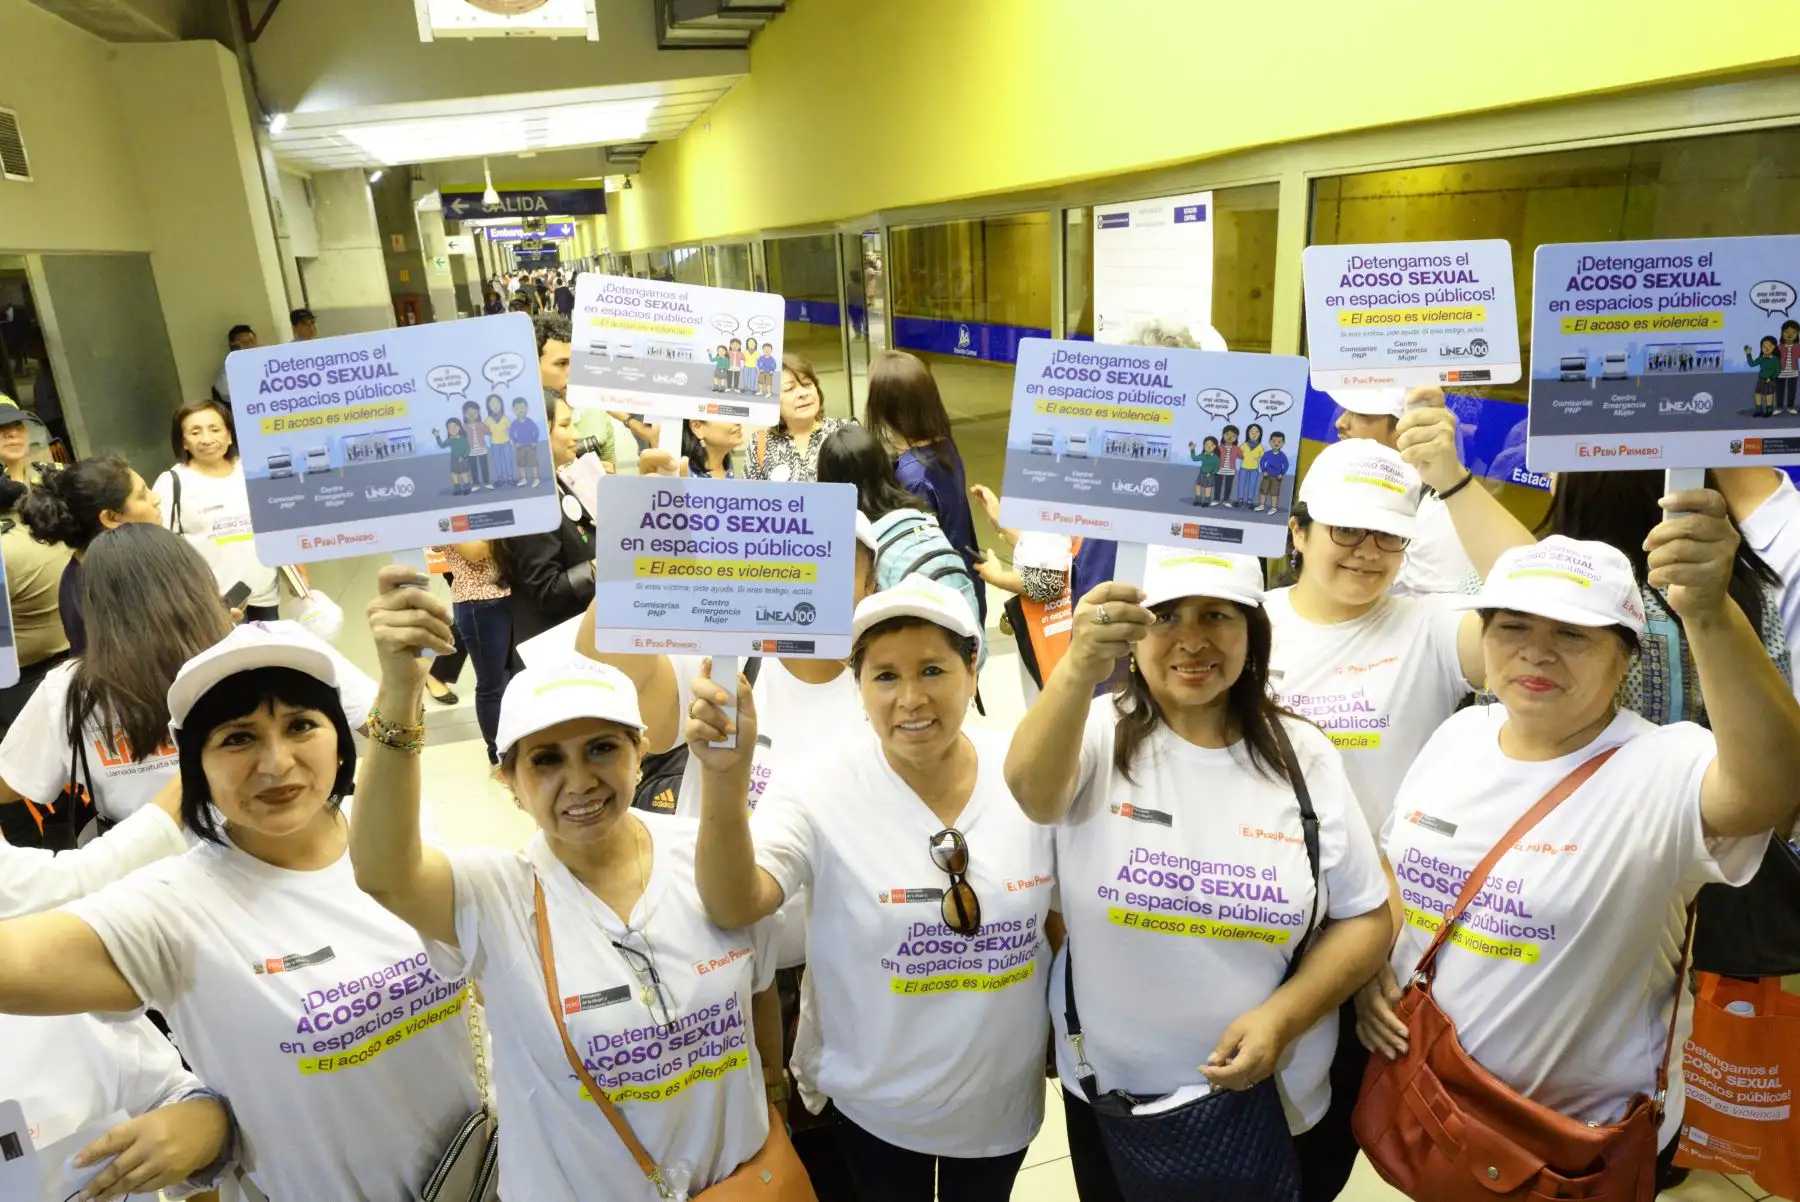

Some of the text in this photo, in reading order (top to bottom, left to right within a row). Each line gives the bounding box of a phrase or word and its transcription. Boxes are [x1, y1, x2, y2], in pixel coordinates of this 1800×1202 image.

[490, 227, 533, 239] Embarq
[1347, 252, 1469, 272] ¡Detengamos el
[1577, 252, 1712, 274] ¡Detengamos el
[1339, 270, 1479, 288] ACOSO SEXUAL
[1566, 272, 1721, 292] ACOSO SEXUAL
[603, 283, 688, 300] ¡Detengamos el
[1326, 287, 1495, 308] en espacios públicos!
[1549, 299, 1569, 312] en
[1575, 294, 1653, 314] espacios
[1658, 291, 1737, 312] públicos!
[584, 305, 598, 314] en
[601, 307, 651, 320] espacios
[654, 312, 703, 325] públicos!
[596, 294, 694, 313] ACOSO SEXUAL
[1352, 310, 1473, 324] El acoso es violencia
[1575, 315, 1709, 331] El acoso es violencia
[264, 345, 387, 375] ¡Detengamos el
[1051, 350, 1167, 371] ¡Detengamos el
[258, 362, 398, 395] ACOSO SEXUAL
[1042, 366, 1174, 389] ACOSO SEXUAL
[246, 401, 266, 415] en
[270, 389, 341, 413] espacios
[345, 378, 416, 405] públicos!
[1026, 383, 1044, 394] en
[1048, 385, 1114, 403] espacios
[1118, 390, 1186, 407] públicos!
[273, 405, 394, 431] El acoso es violencia
[1046, 402, 1160, 423] El acoso es violencia
[652, 491, 804, 513] ¡Detengamos el
[640, 512, 814, 535] ACOSO SEXUAL
[621, 538, 831, 559] en espacios públicos!
[651, 561, 800, 579] El acoso es violencia
[692, 607, 741, 616] Emergencia
[701, 599, 729, 607] Centro
[704, 615, 728, 624] Mujer
[1332, 736, 1368, 746] lencia
[1129, 847, 1276, 881] ¡Detengamos el
[1117, 866, 1289, 904] ACOSO SEXUAL
[1506, 879, 1523, 895] el
[1098, 885, 1304, 926] en espacios públicos!
[1471, 891, 1532, 919] EXUAL
[1026, 914, 1037, 929] el
[1124, 912, 1276, 943] El acoso es violencia
[1472, 912, 1556, 940] públicos!
[897, 929, 1037, 957] ACOSO SEXUAL
[1453, 930, 1522, 957] es violencia
[881, 958, 983, 976] en espacios
[301, 952, 428, 1015] ¡Detengamo
[905, 969, 1029, 993] El acoso es violencia
[296, 991, 382, 1034] ACOSO
[587, 991, 738, 1057] ¡Detengamos el
[280, 1005, 404, 1054] en espacios
[318, 1059, 333, 1070] El
[339, 1041, 381, 1067] acoso
[386, 1030, 401, 1046] es
[583, 1042, 662, 1073] ACOSO
[615, 1056, 737, 1102] acoso es violencia
[1683, 1053, 1783, 1088] COSO SEXUAL
[1768, 1064, 1779, 1075] el
[1683, 1070, 1791, 1103] spacios públicos!
[1685, 1086, 1781, 1119] coso es violencia
